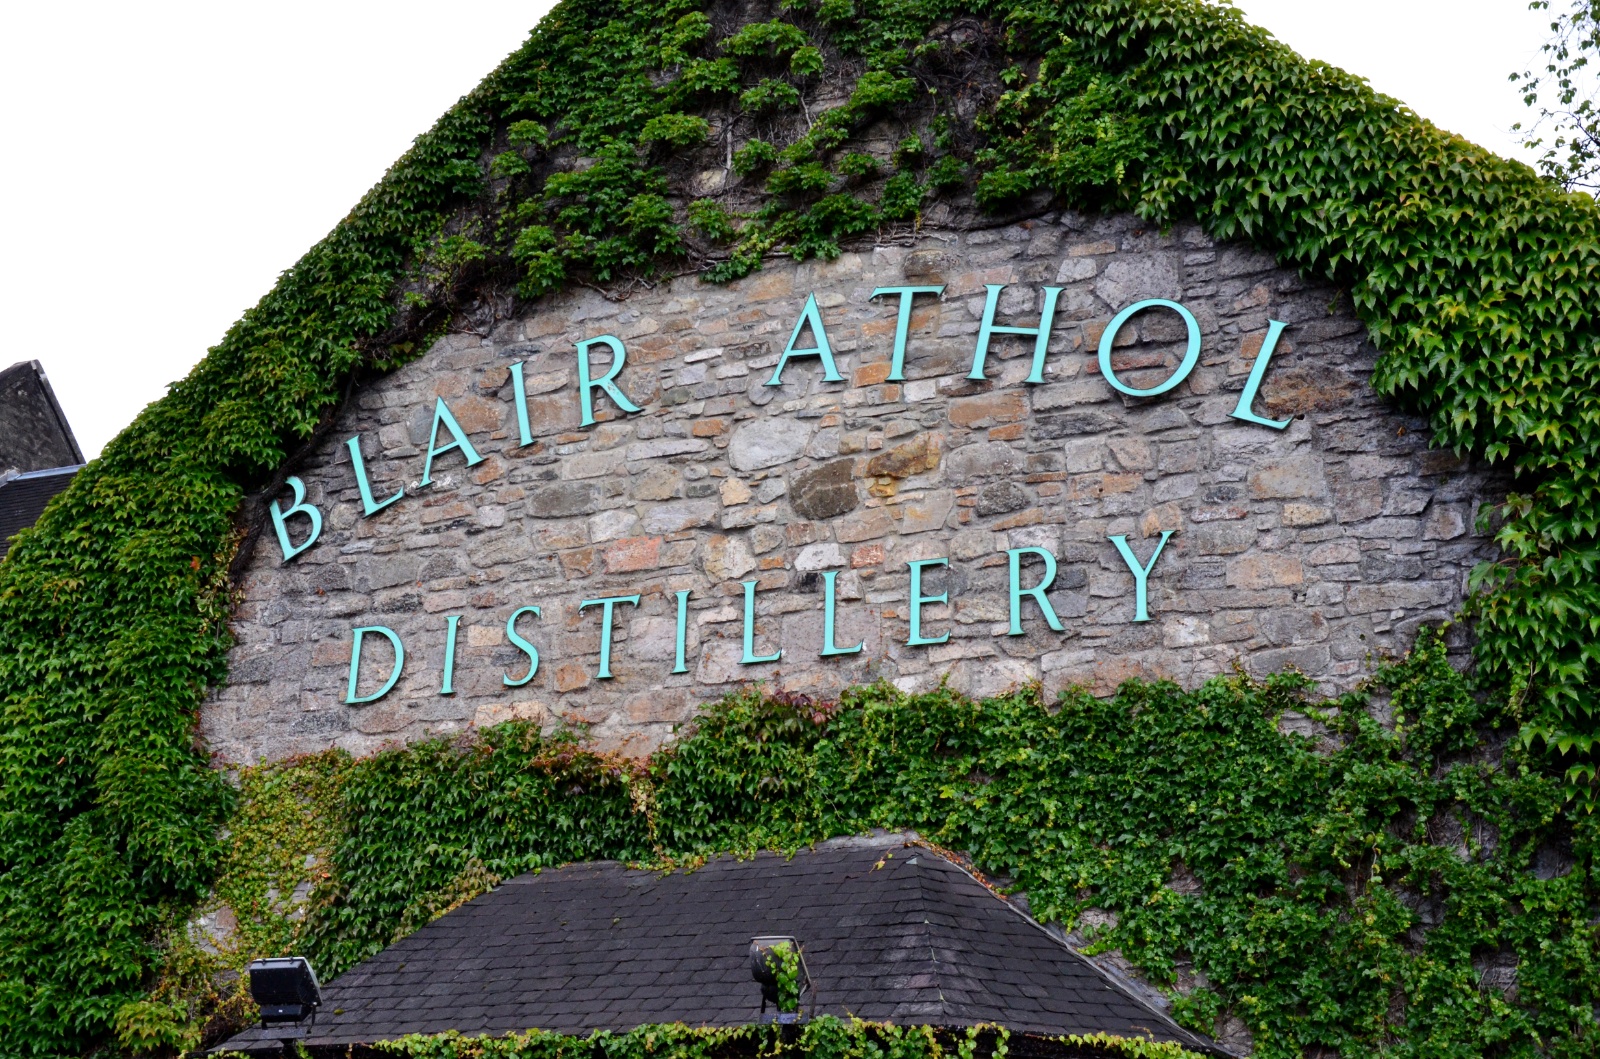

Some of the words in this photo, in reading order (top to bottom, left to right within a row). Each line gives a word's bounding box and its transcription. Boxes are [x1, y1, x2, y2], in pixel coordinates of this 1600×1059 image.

[269, 334, 642, 562] BLAIR
[764, 283, 1293, 430] ATHOL
[345, 529, 1175, 705] DISTILLERY
